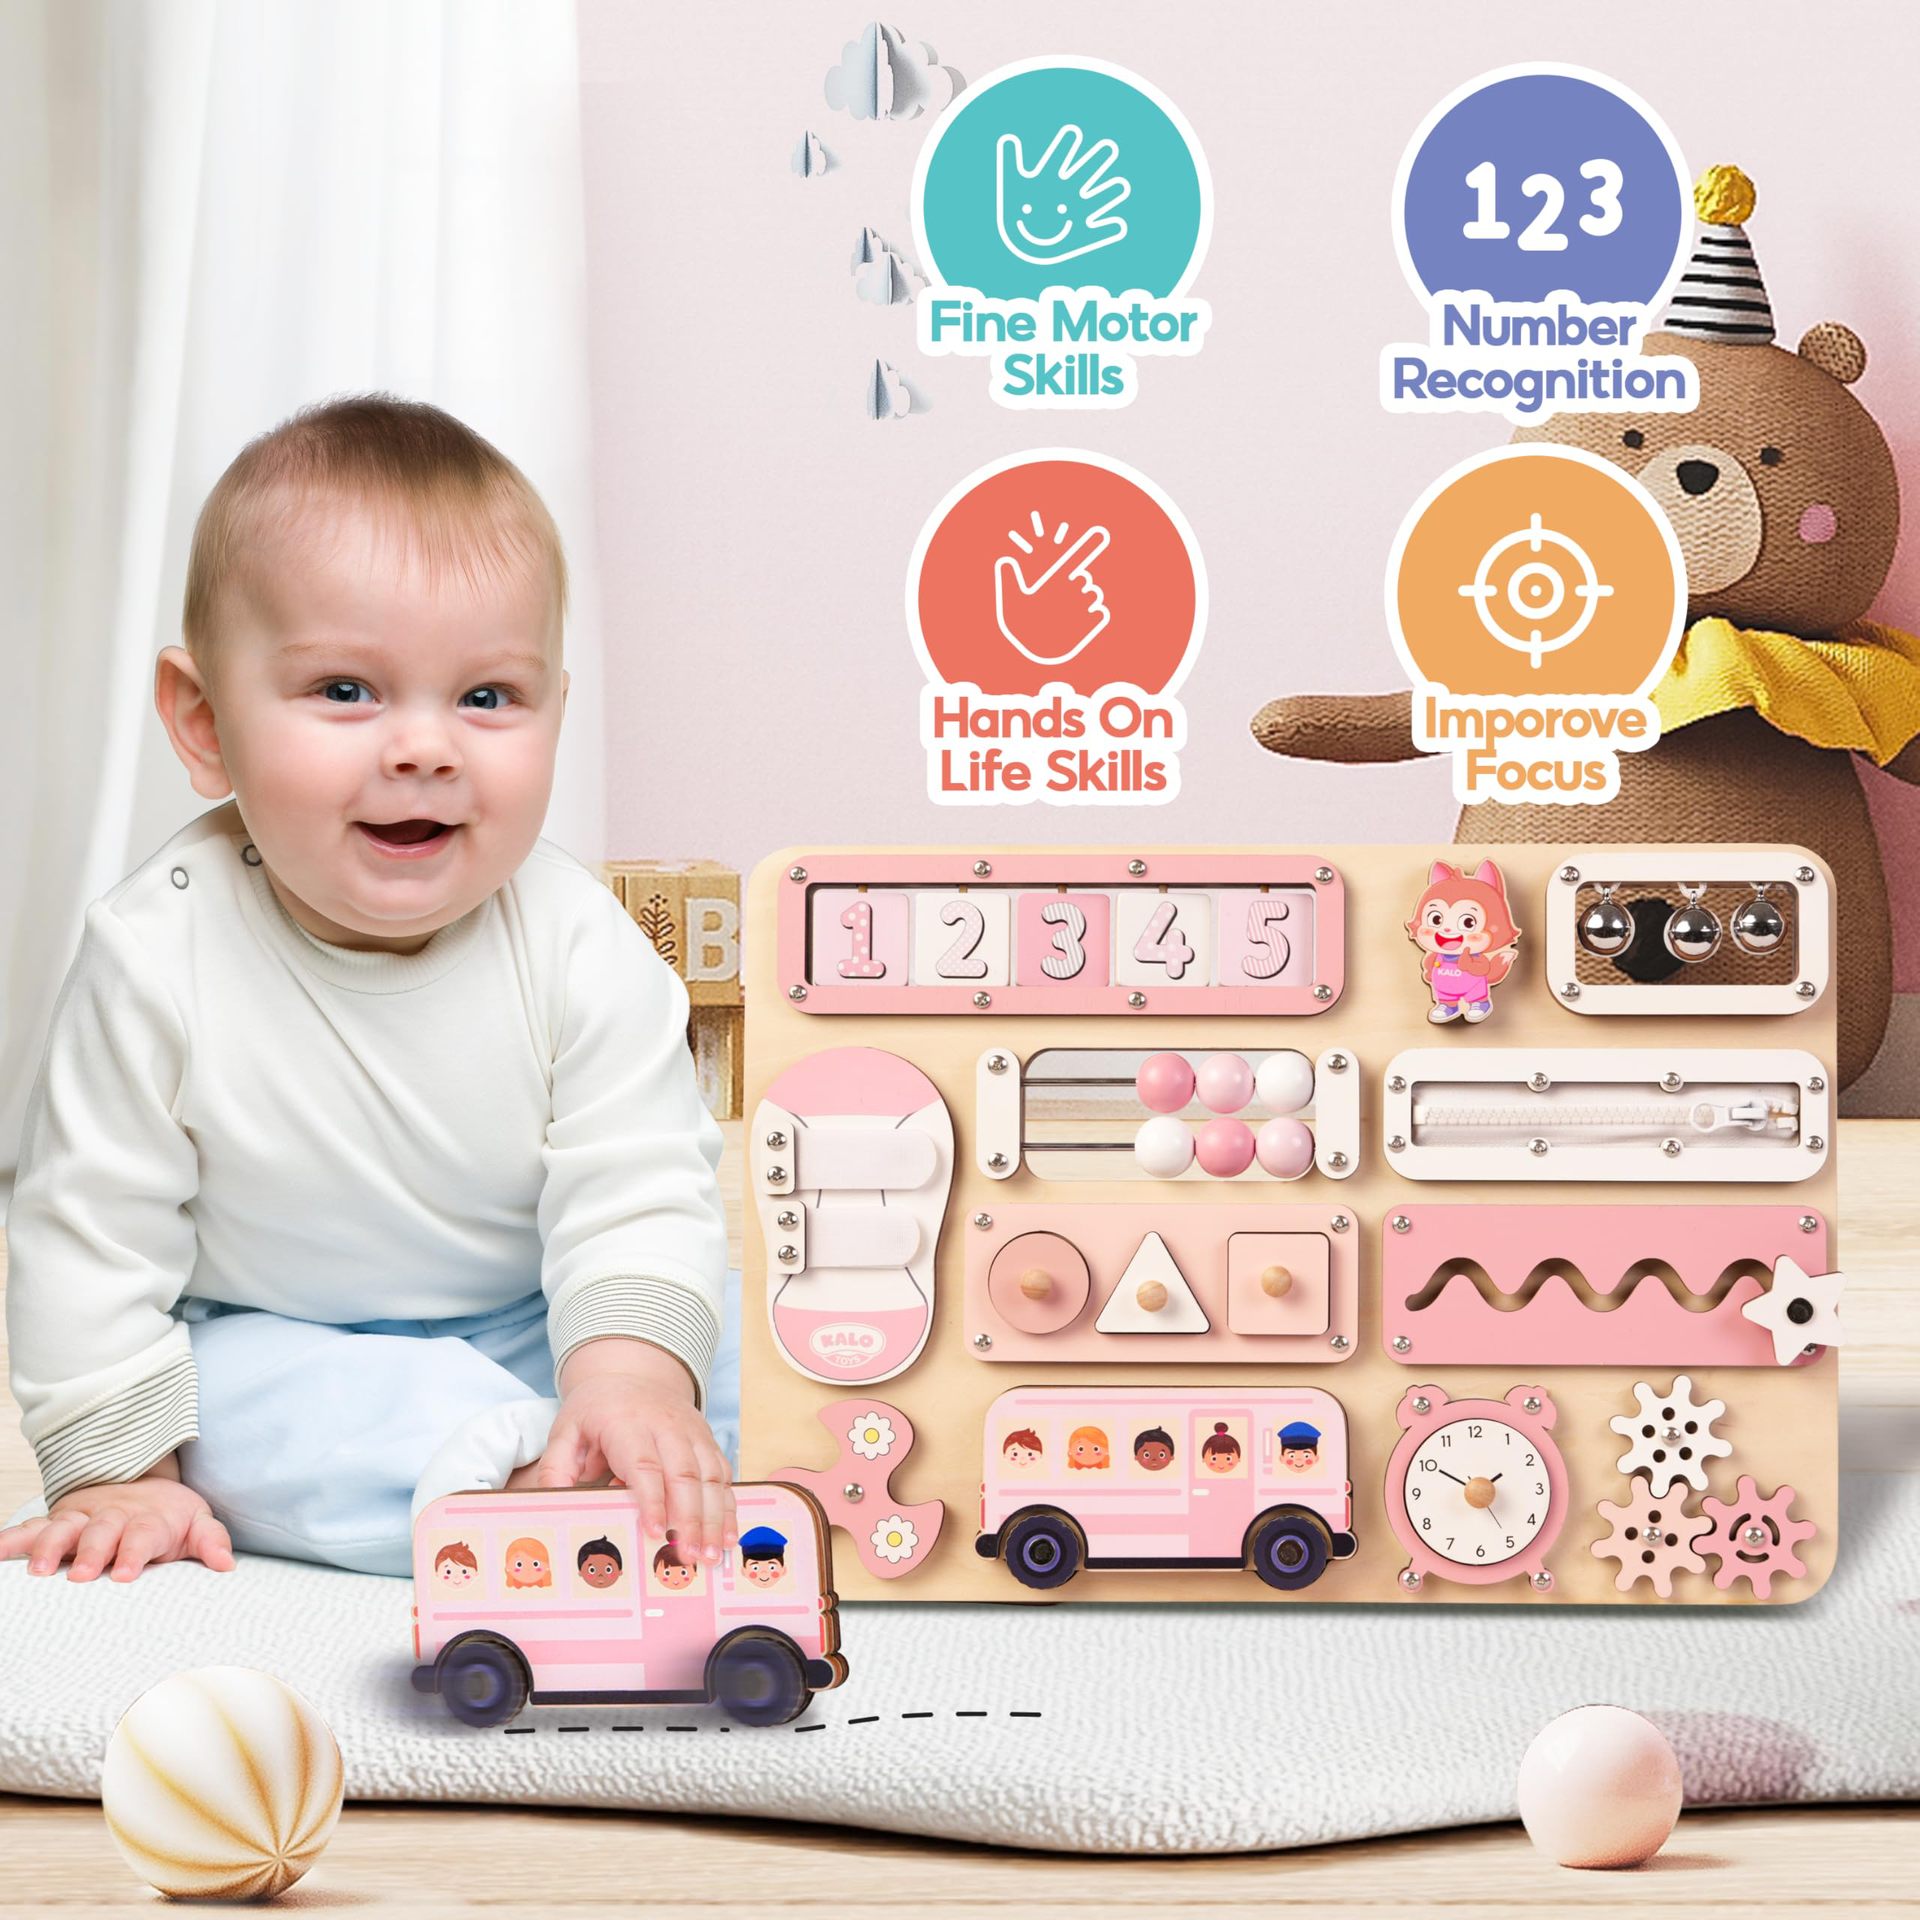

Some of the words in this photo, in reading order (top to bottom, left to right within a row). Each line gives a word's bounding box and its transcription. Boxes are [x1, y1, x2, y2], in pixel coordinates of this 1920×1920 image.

[685, 898, 740, 982] B
[836, 901, 887, 979] 1
[936, 901, 989, 979] 2
[1040, 901, 1087, 980] 3
[1133, 901, 1195, 980] 4
[1241, 901, 1291, 980] 5
[1437, 967, 1462, 977] KALO
[820, 1332, 874, 1348] KALO
[834, 1354, 861, 1366] TOYS
[1467, 1425, 1483, 1438] 12
[1441, 1435, 1451, 1447] 11
[1505, 1433, 1510, 1445] 1
[1419, 1459, 1438, 1472] 10
[1525, 1454, 1535, 1467] 2
[1412, 1488, 1422, 1501] 9
[1535, 1483, 1544, 1496] 3
[1422, 1517, 1432, 1531] 8
[1527, 1513, 1537, 1526] 4
[1446, 1537, 1455, 1550] 7
[1506, 1536, 1515, 1549] 5
[1476, 1545, 1486, 1558] 6
